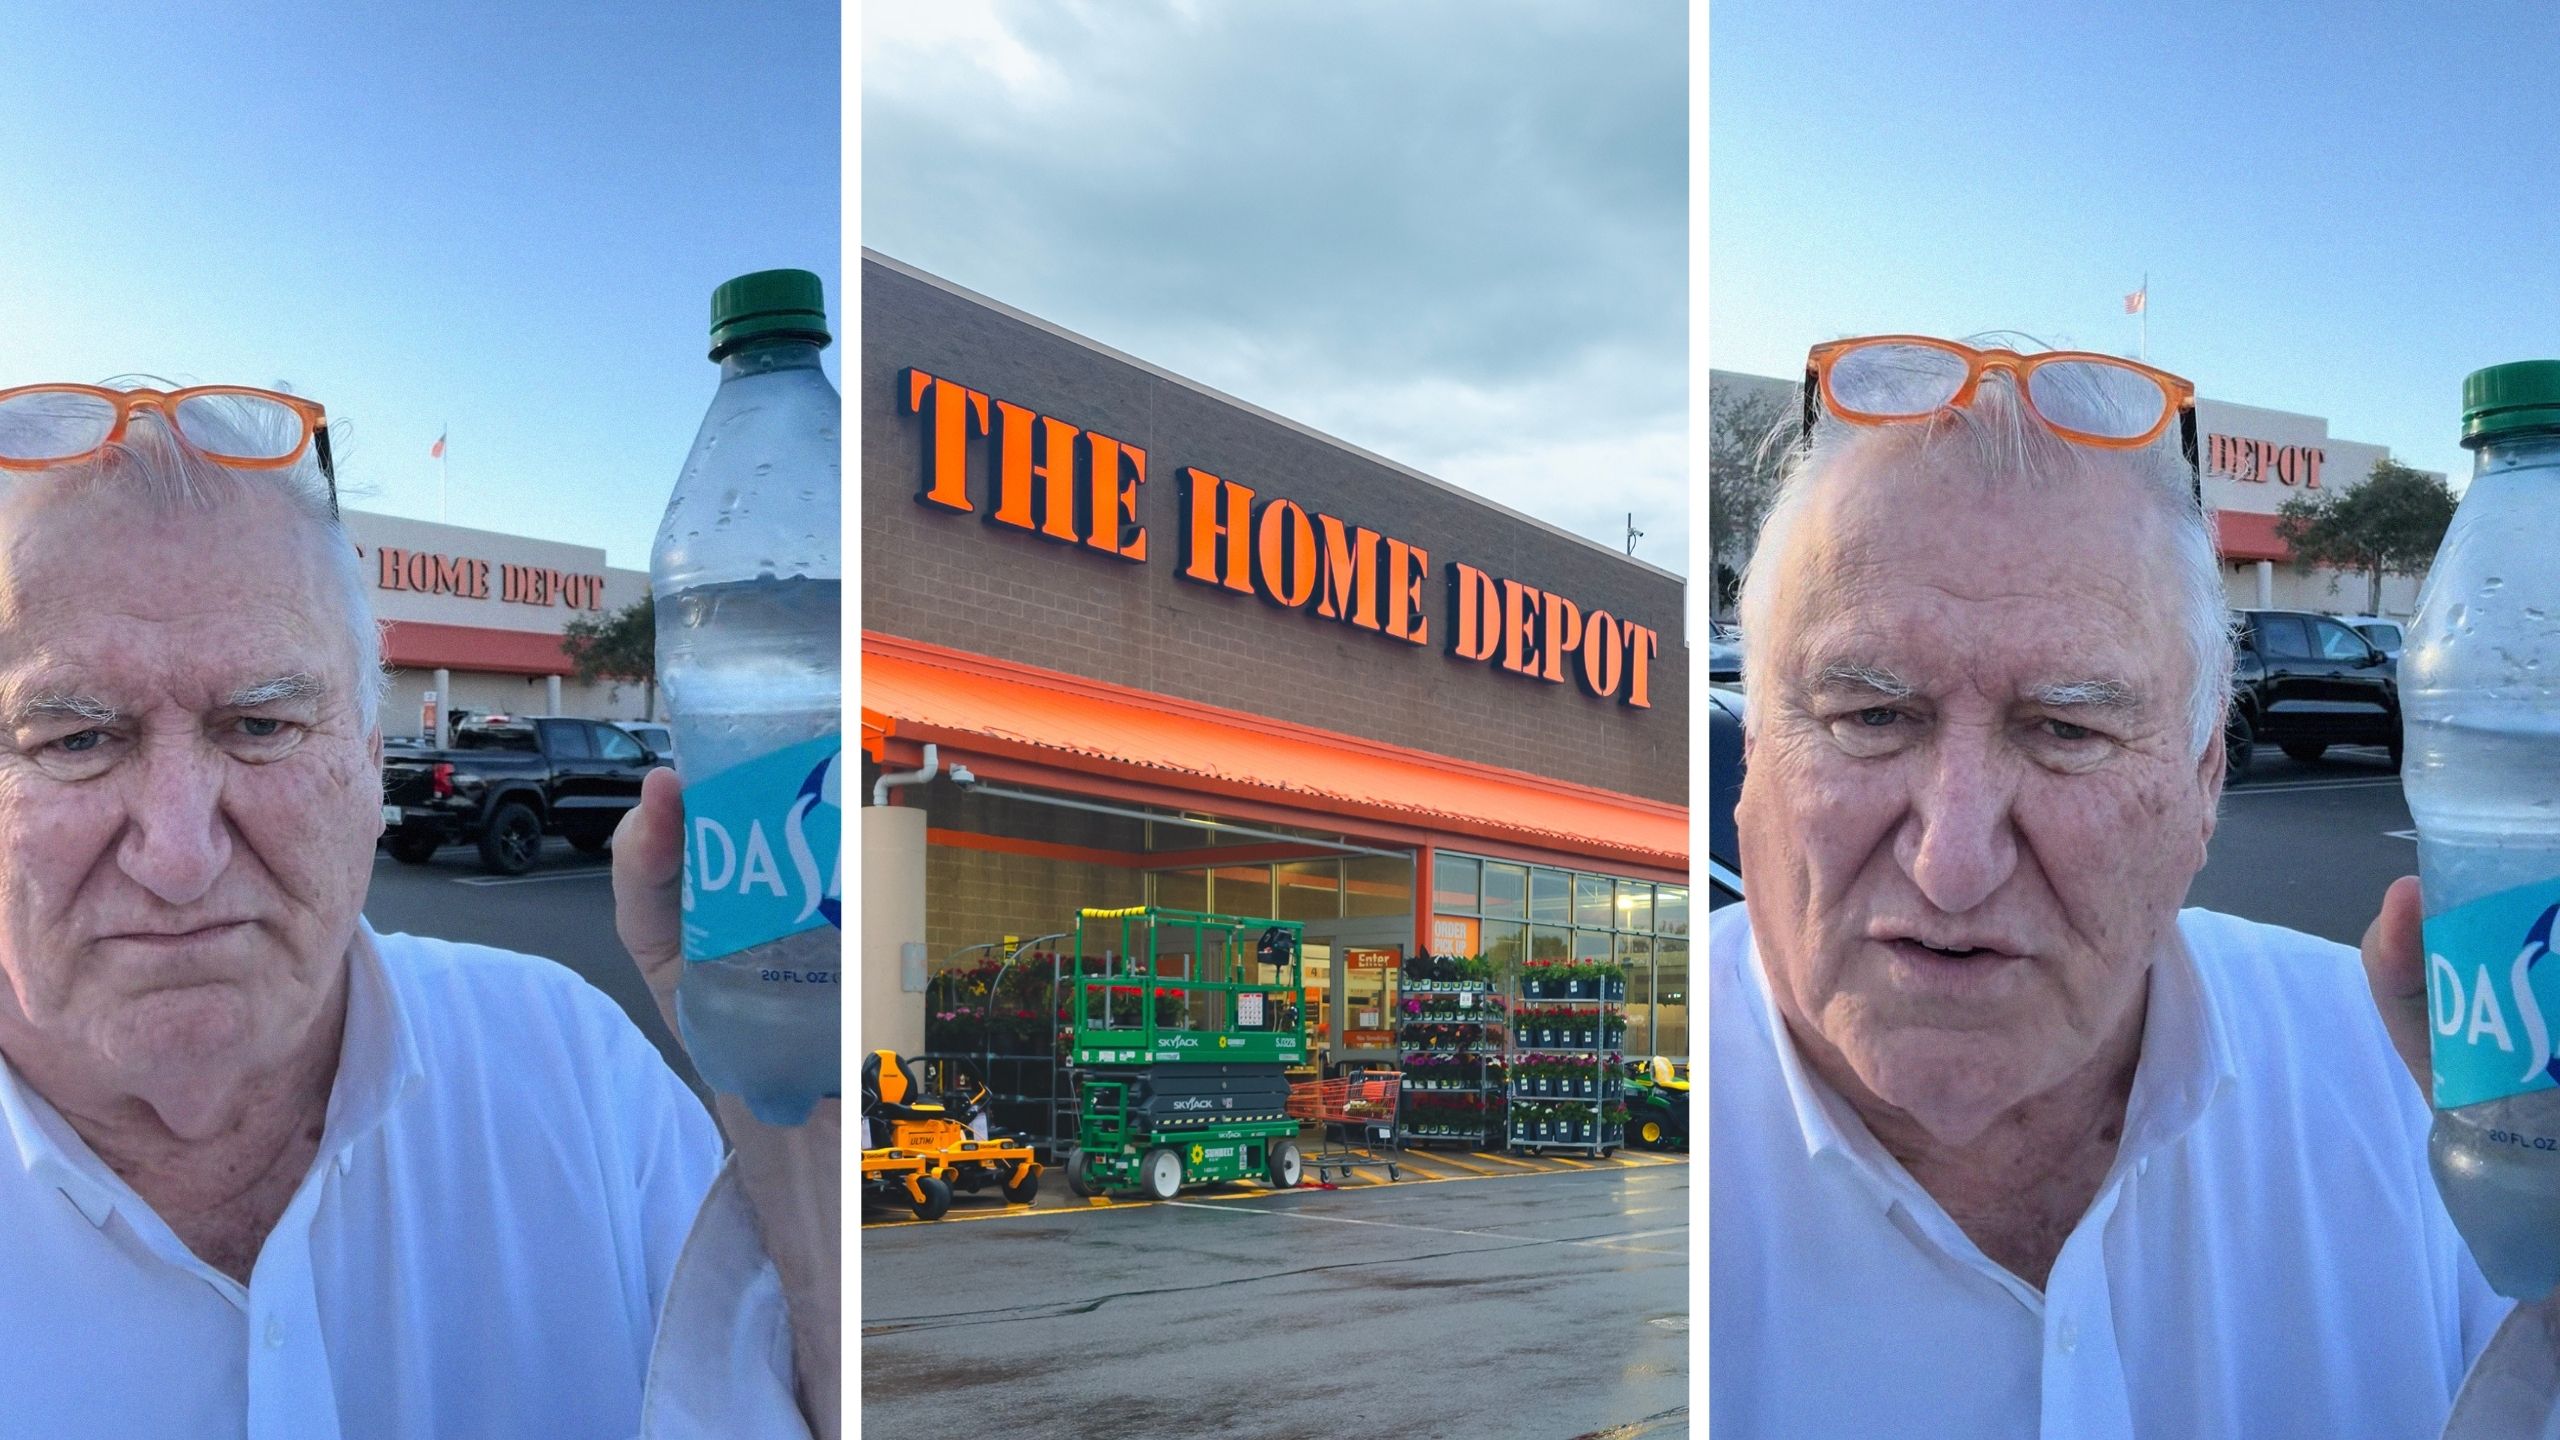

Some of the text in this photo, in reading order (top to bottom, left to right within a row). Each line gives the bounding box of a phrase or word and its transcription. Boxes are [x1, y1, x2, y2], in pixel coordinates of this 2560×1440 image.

[2208, 433, 2324, 489] DEPOT
[901, 366, 1659, 710] THE HOME DEPOT
[378, 547, 604, 610] HOME DEPOT
[695, 792, 841, 925] DAS
[1434, 920, 1467, 939] ORDER
[1456, 940, 1466, 954] UP
[1358, 953, 1390, 967] Enter
[761, 969, 780, 981] 20
[783, 970, 802, 984] FL
[806, 971, 828, 984] OZ
[2431, 940, 2560, 1084] DAS
[1158, 1034, 1199, 1049] SKYJACK
[1275, 1037, 1297, 1048] SJ3226
[1173, 1096, 1213, 1110] SKYJACK
[2489, 1129, 2557, 1151] 20 FL OZ
